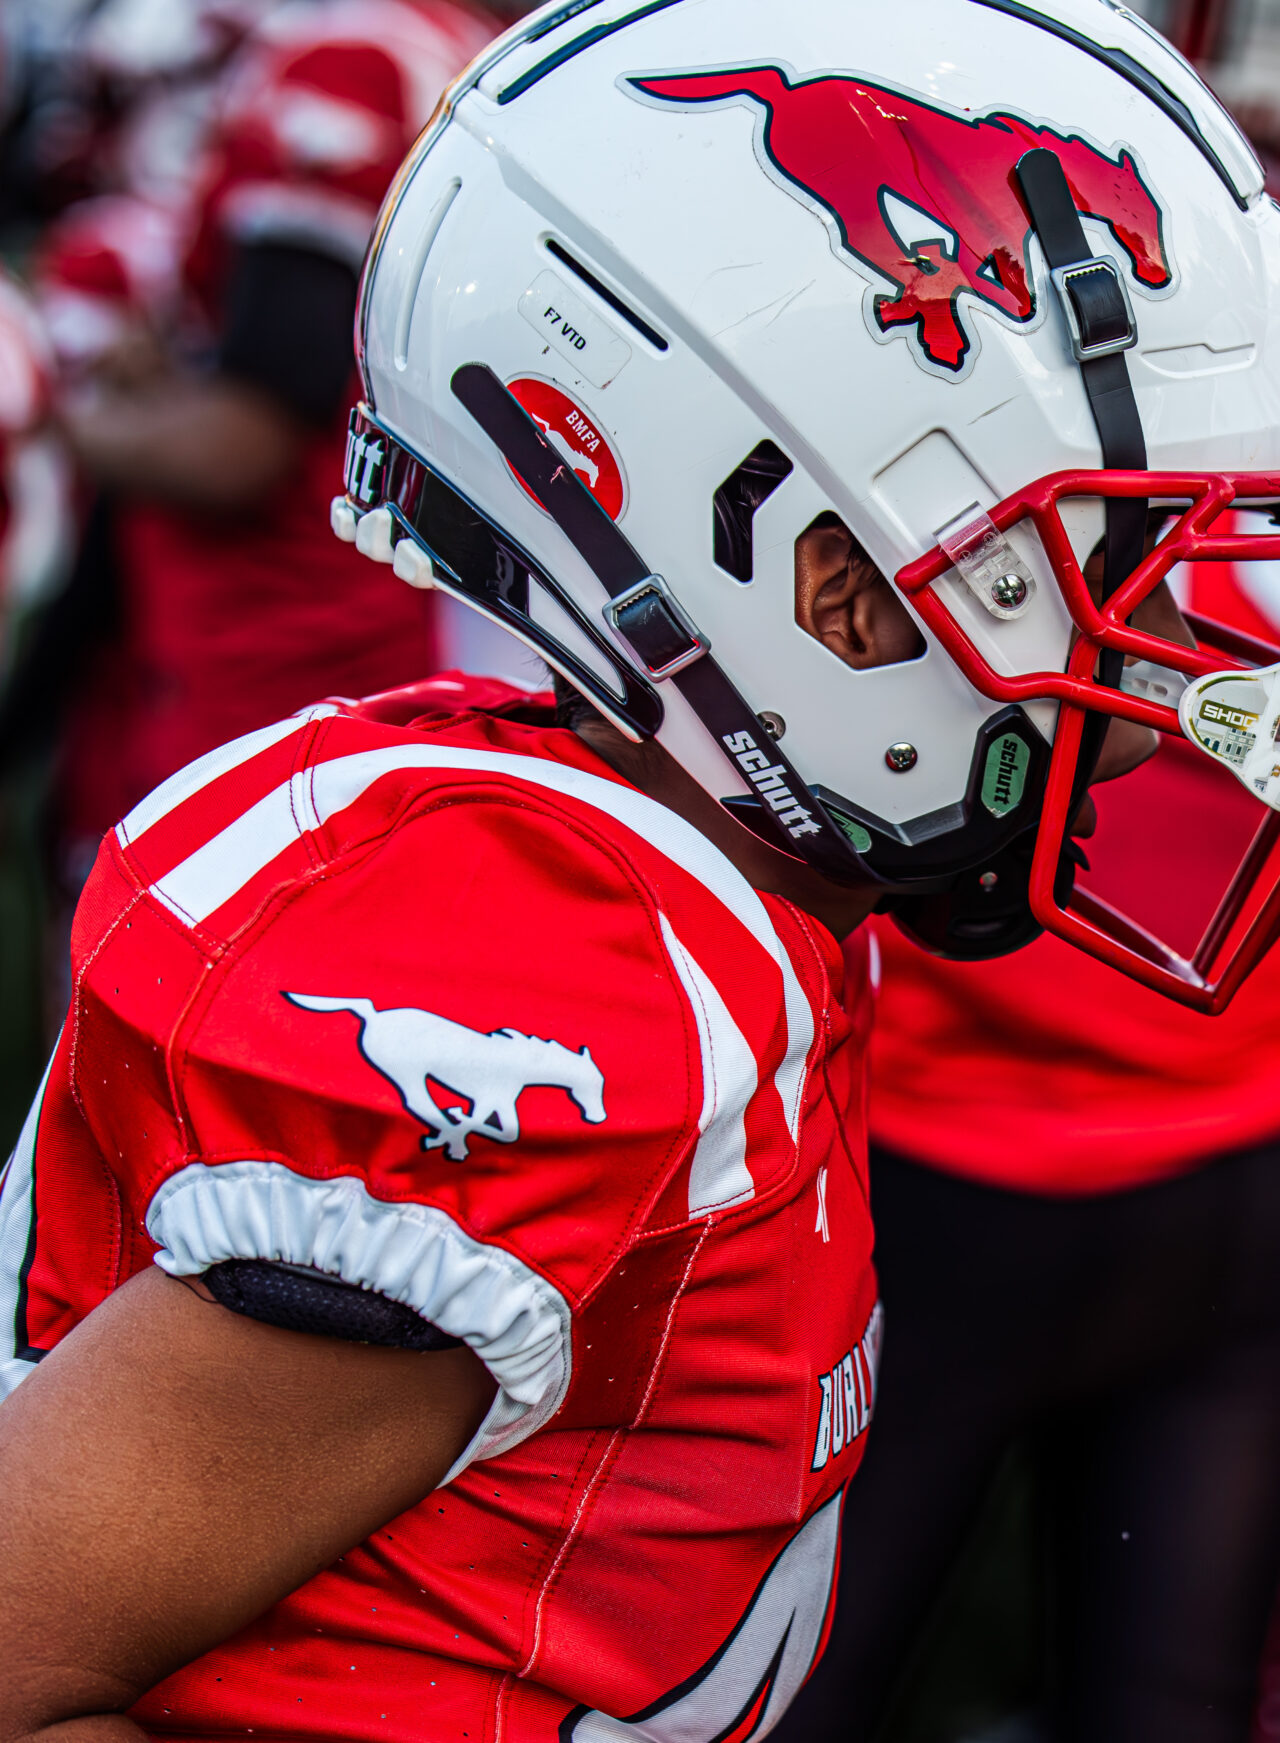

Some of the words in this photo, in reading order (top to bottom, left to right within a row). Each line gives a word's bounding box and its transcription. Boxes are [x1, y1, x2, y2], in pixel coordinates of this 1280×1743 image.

[542, 306, 562, 325] F7
[560, 322, 587, 351] VTD
[565, 410, 601, 453] BMFA
[722, 730, 822, 840] schutt
[993, 738, 1019, 805] schutt
